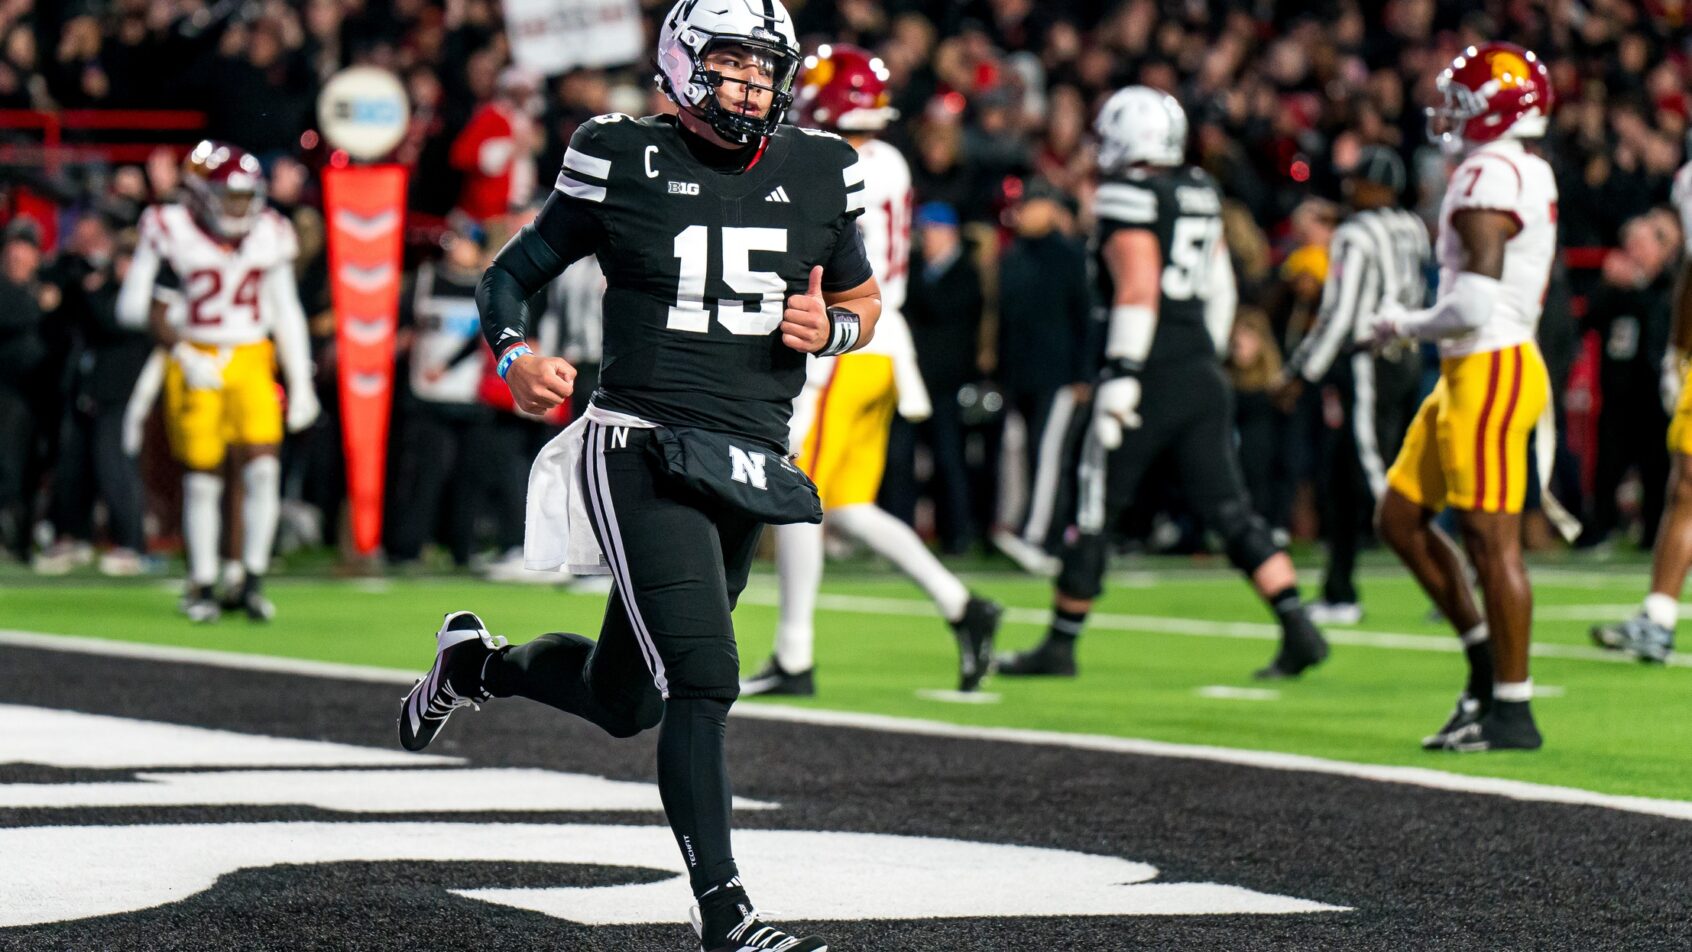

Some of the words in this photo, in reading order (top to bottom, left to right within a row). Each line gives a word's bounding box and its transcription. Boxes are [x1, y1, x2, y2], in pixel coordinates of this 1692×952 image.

[645, 145, 659, 178] C
[1464, 167, 1483, 197] 7
[188, 268, 263, 326] 24
[666, 225, 788, 336] 15
[611, 426, 629, 448] N
[729, 445, 768, 490] N
